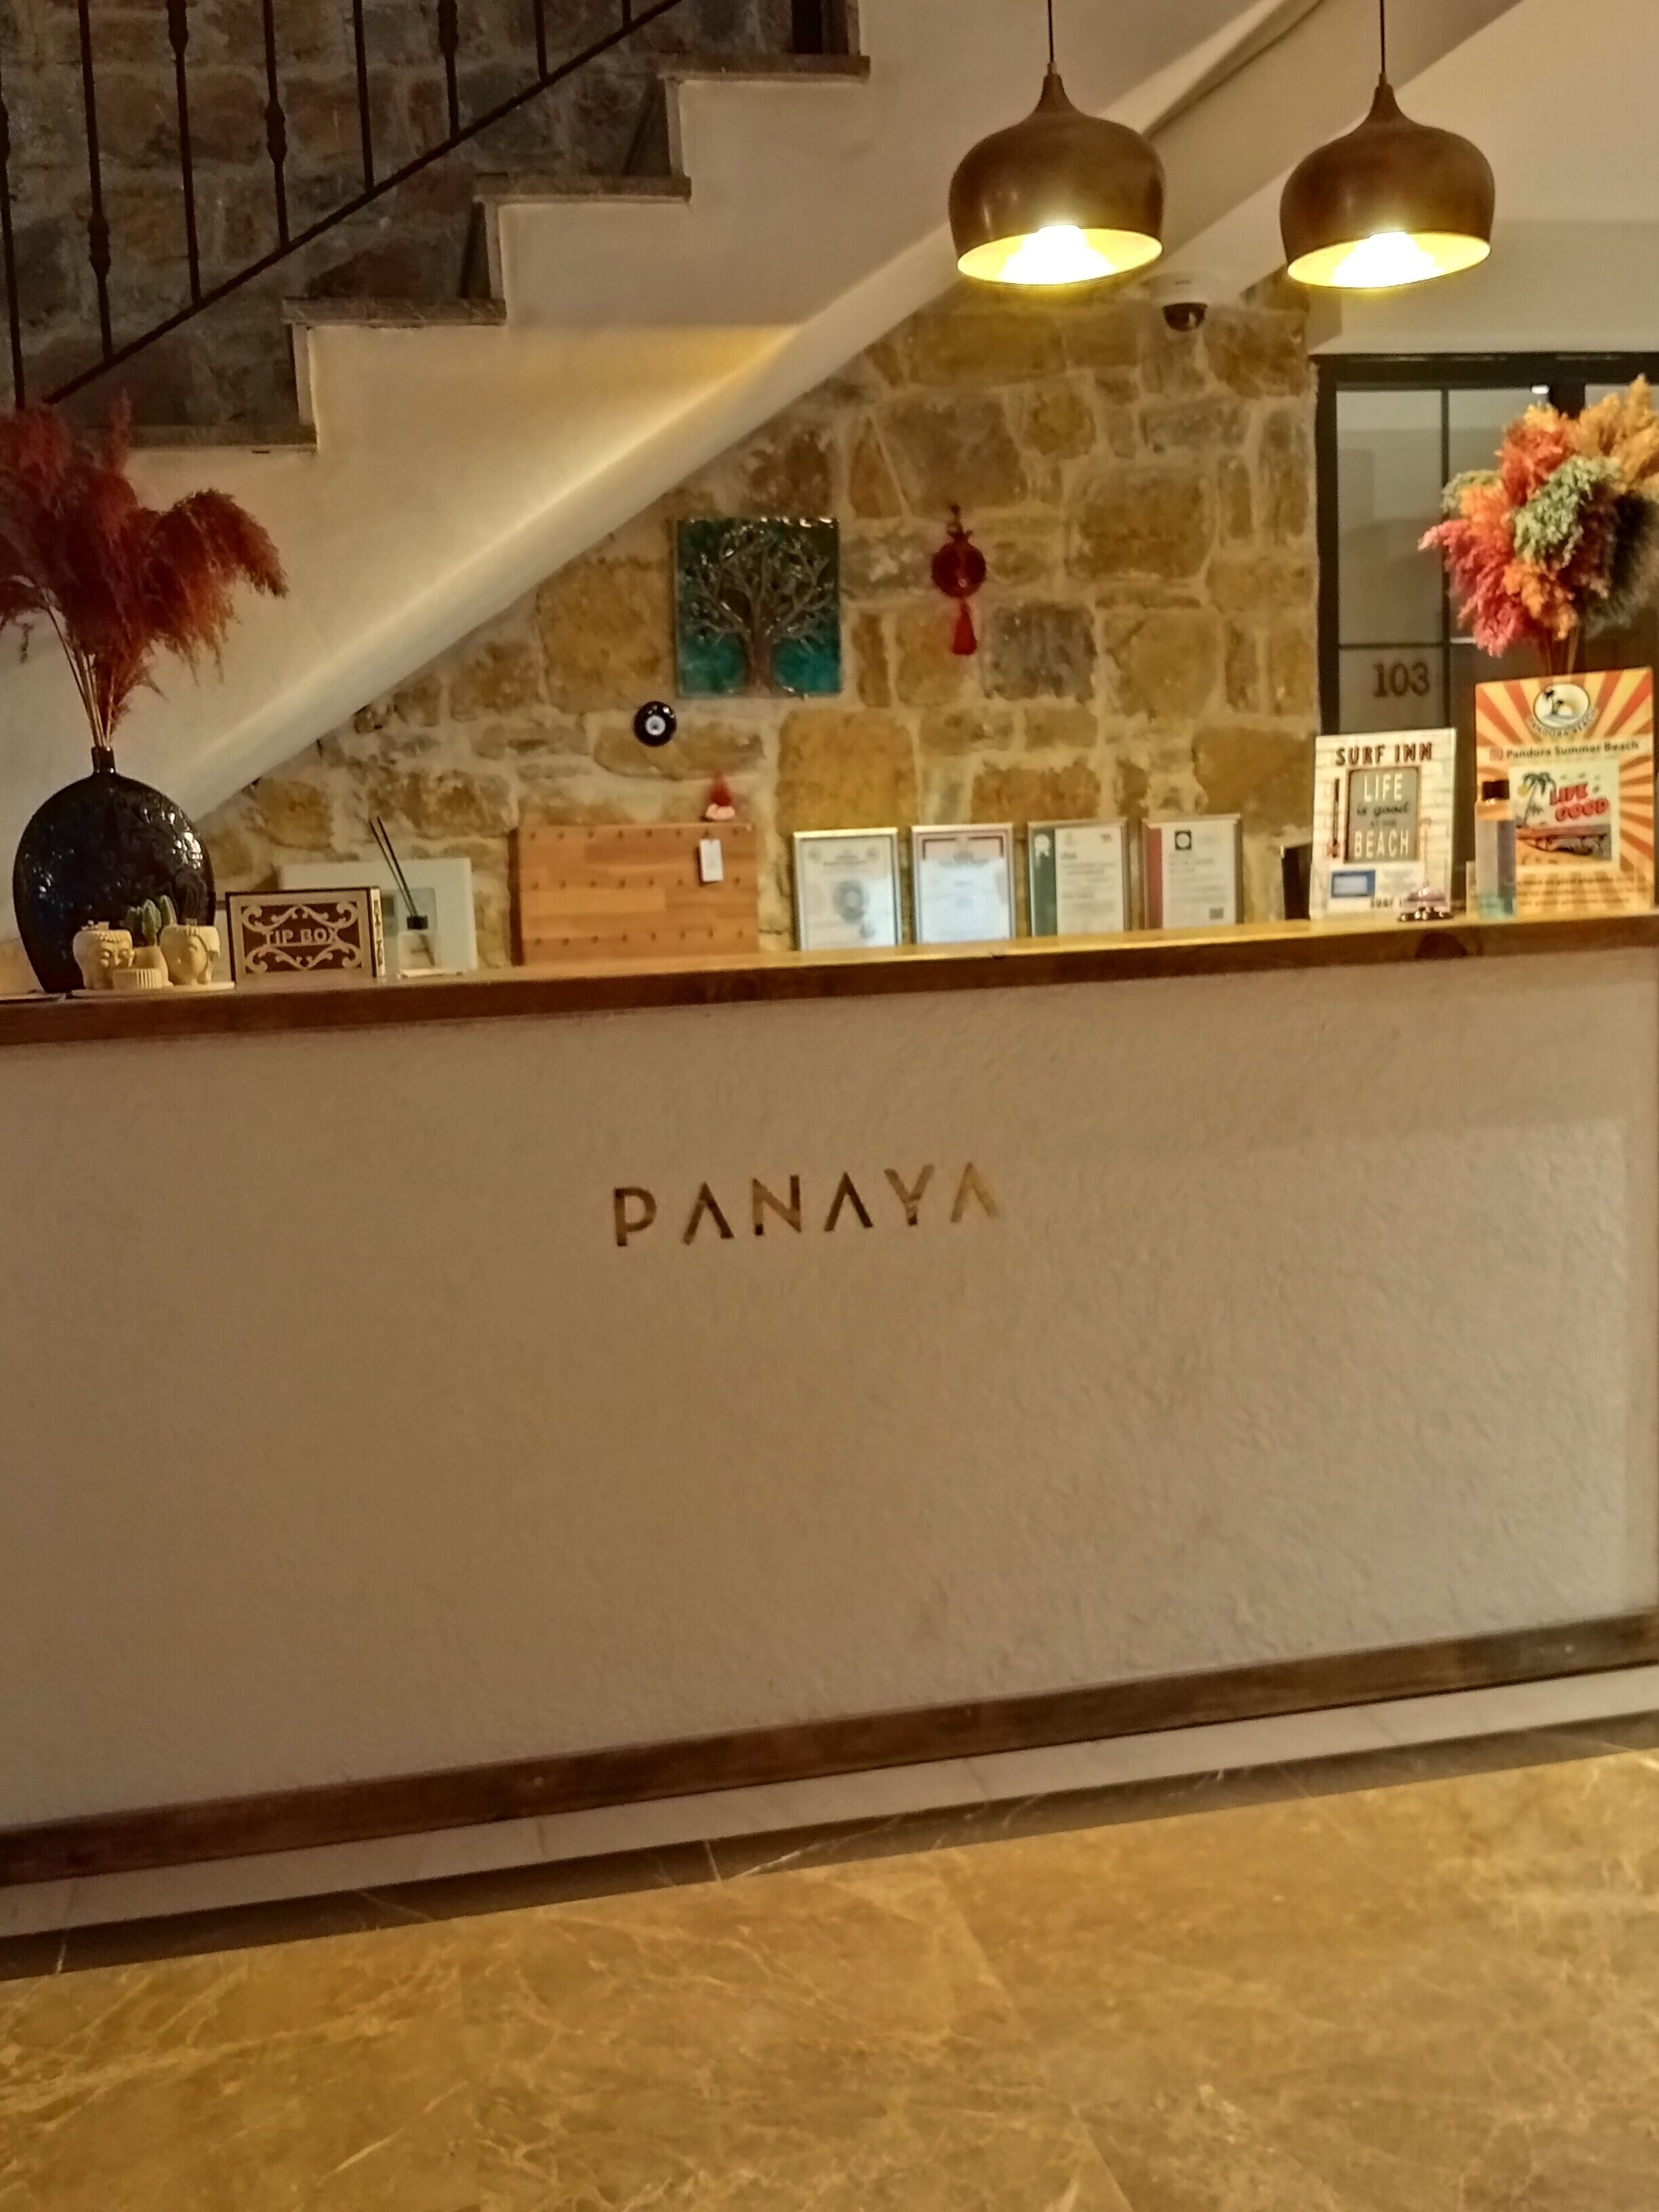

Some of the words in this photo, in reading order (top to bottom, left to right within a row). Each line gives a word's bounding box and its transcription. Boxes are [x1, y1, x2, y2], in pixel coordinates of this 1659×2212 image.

[1373, 662, 1431, 697] 103
[1336, 744, 1385, 766] SURF
[1395, 741, 1432, 762] INN
[1507, 746, 1551, 759] Pandora
[1555, 743, 1601, 756] Summer
[1603, 739, 1639, 752] Beach
[1364, 773, 1403, 802] LIFE
[1549, 782, 1589, 806] LIFE
[1555, 797, 1609, 822] GOOD
[1354, 829, 1409, 859] BEACH
[266, 928, 294, 945] TIP
[300, 926, 338, 945] BOX
[613, 1161, 1000, 1247] PANAYA
